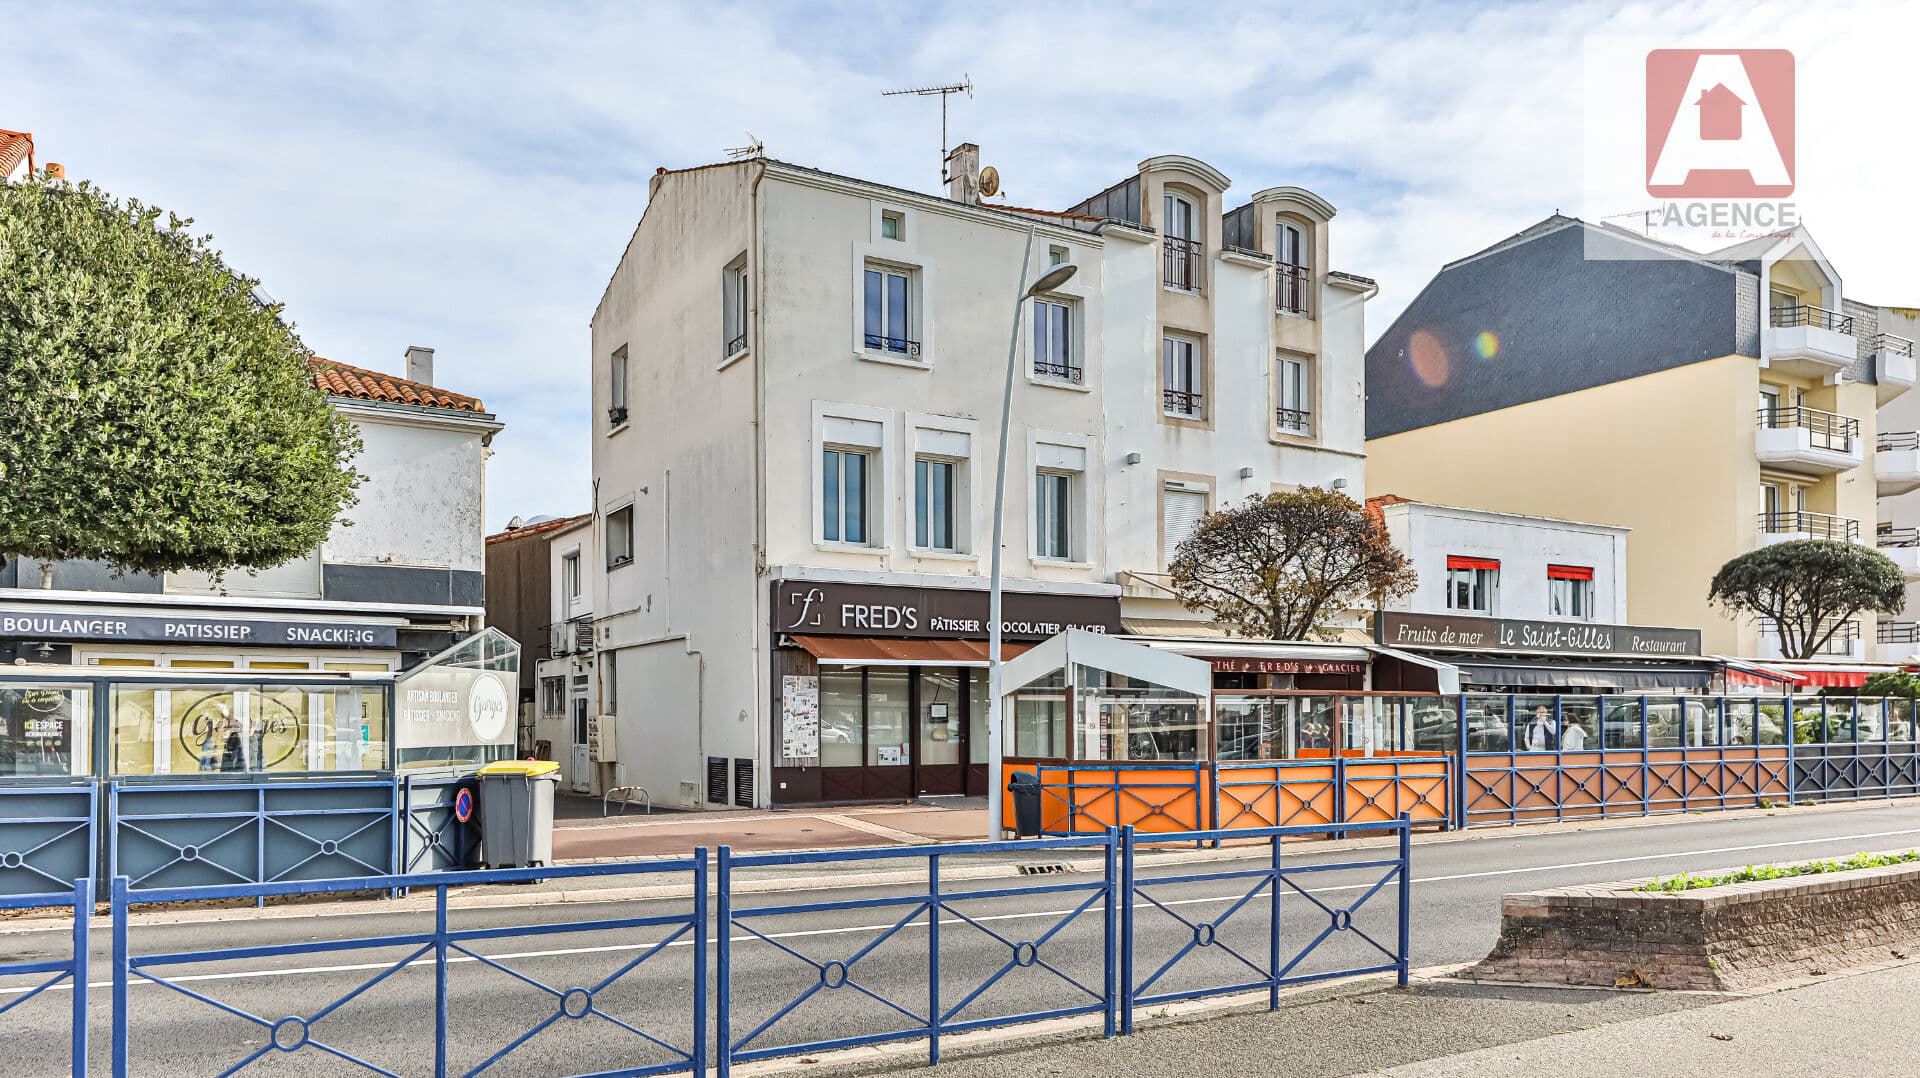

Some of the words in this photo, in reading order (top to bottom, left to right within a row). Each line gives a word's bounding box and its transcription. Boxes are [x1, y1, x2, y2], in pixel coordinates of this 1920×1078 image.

[3, 617, 128, 635] BOULANGER
[165, 623, 253, 640] PATISSIER
[286, 627, 374, 643] SNACKING
[841, 604, 918, 630] FRED'S
[930, 617, 980, 632] PÂTISSIER
[986, 621, 1060, 635] COCOLATIER
[1397, 624, 1436, 643] Fruits
[1440, 625, 1455, 643] de
[1458, 632, 1483, 645] mer
[1500, 624, 1514, 646] Le
[1521, 624, 1611, 650] Saint-Gilles
[1631, 635, 1687, 653] Restaurant
[35, 721, 64, 730] ESPACE
